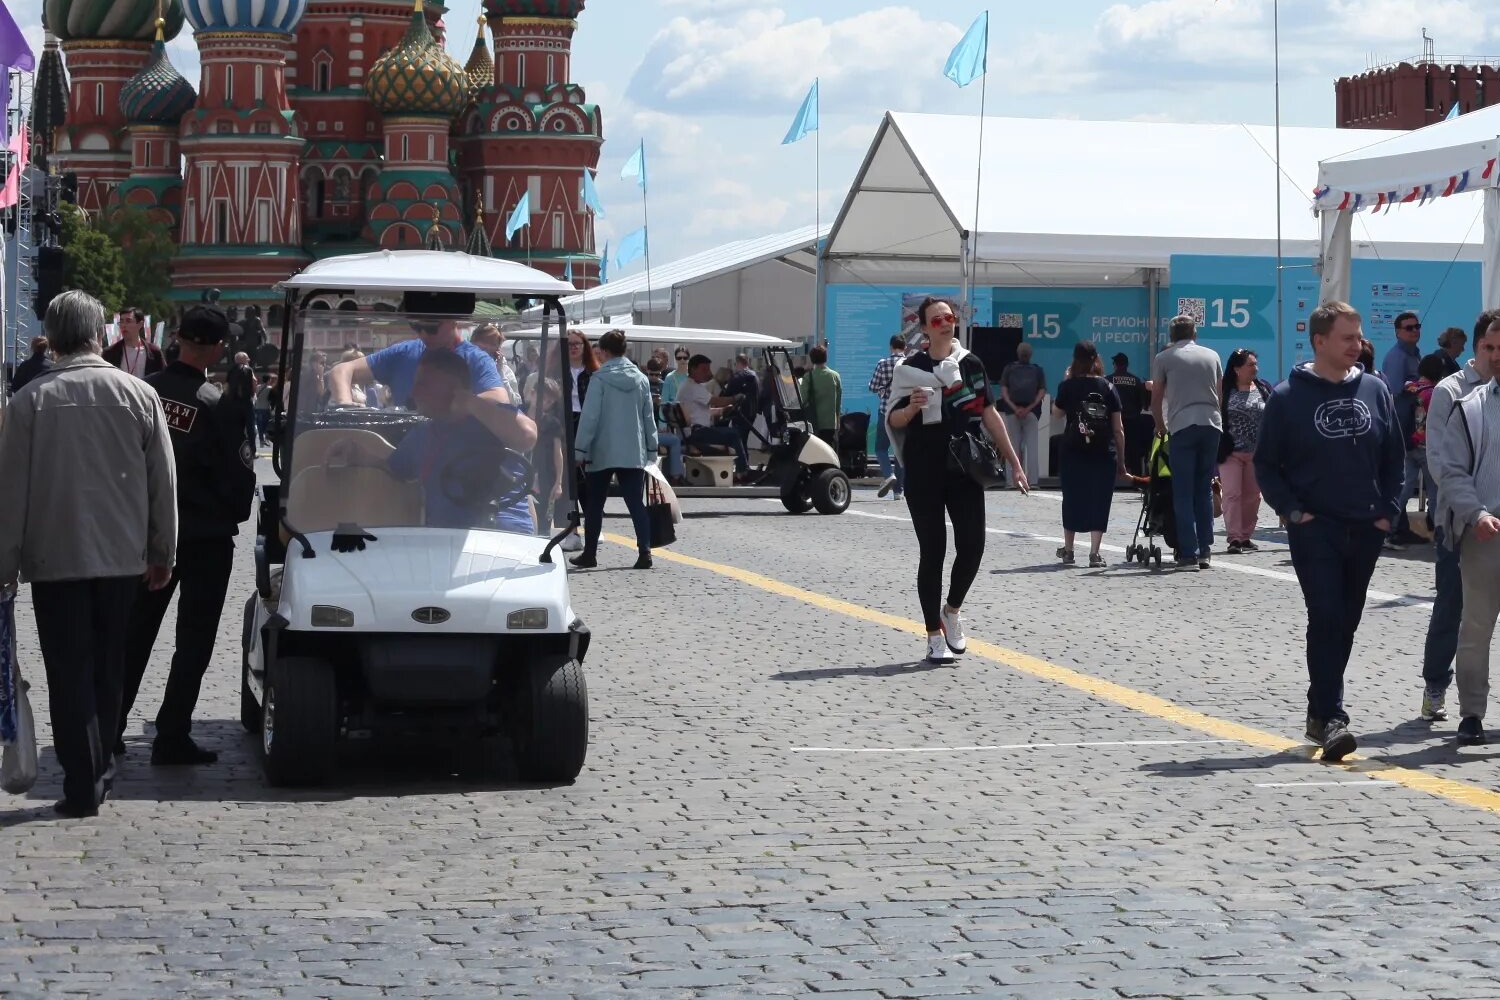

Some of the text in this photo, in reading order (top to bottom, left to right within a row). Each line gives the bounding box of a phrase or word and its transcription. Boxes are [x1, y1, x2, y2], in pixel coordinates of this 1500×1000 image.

[1211, 298, 1250, 328] 15
[1027, 313, 1061, 338] 15
[1092, 332, 1101, 343] И
[165, 402, 190, 417] КАЯ
